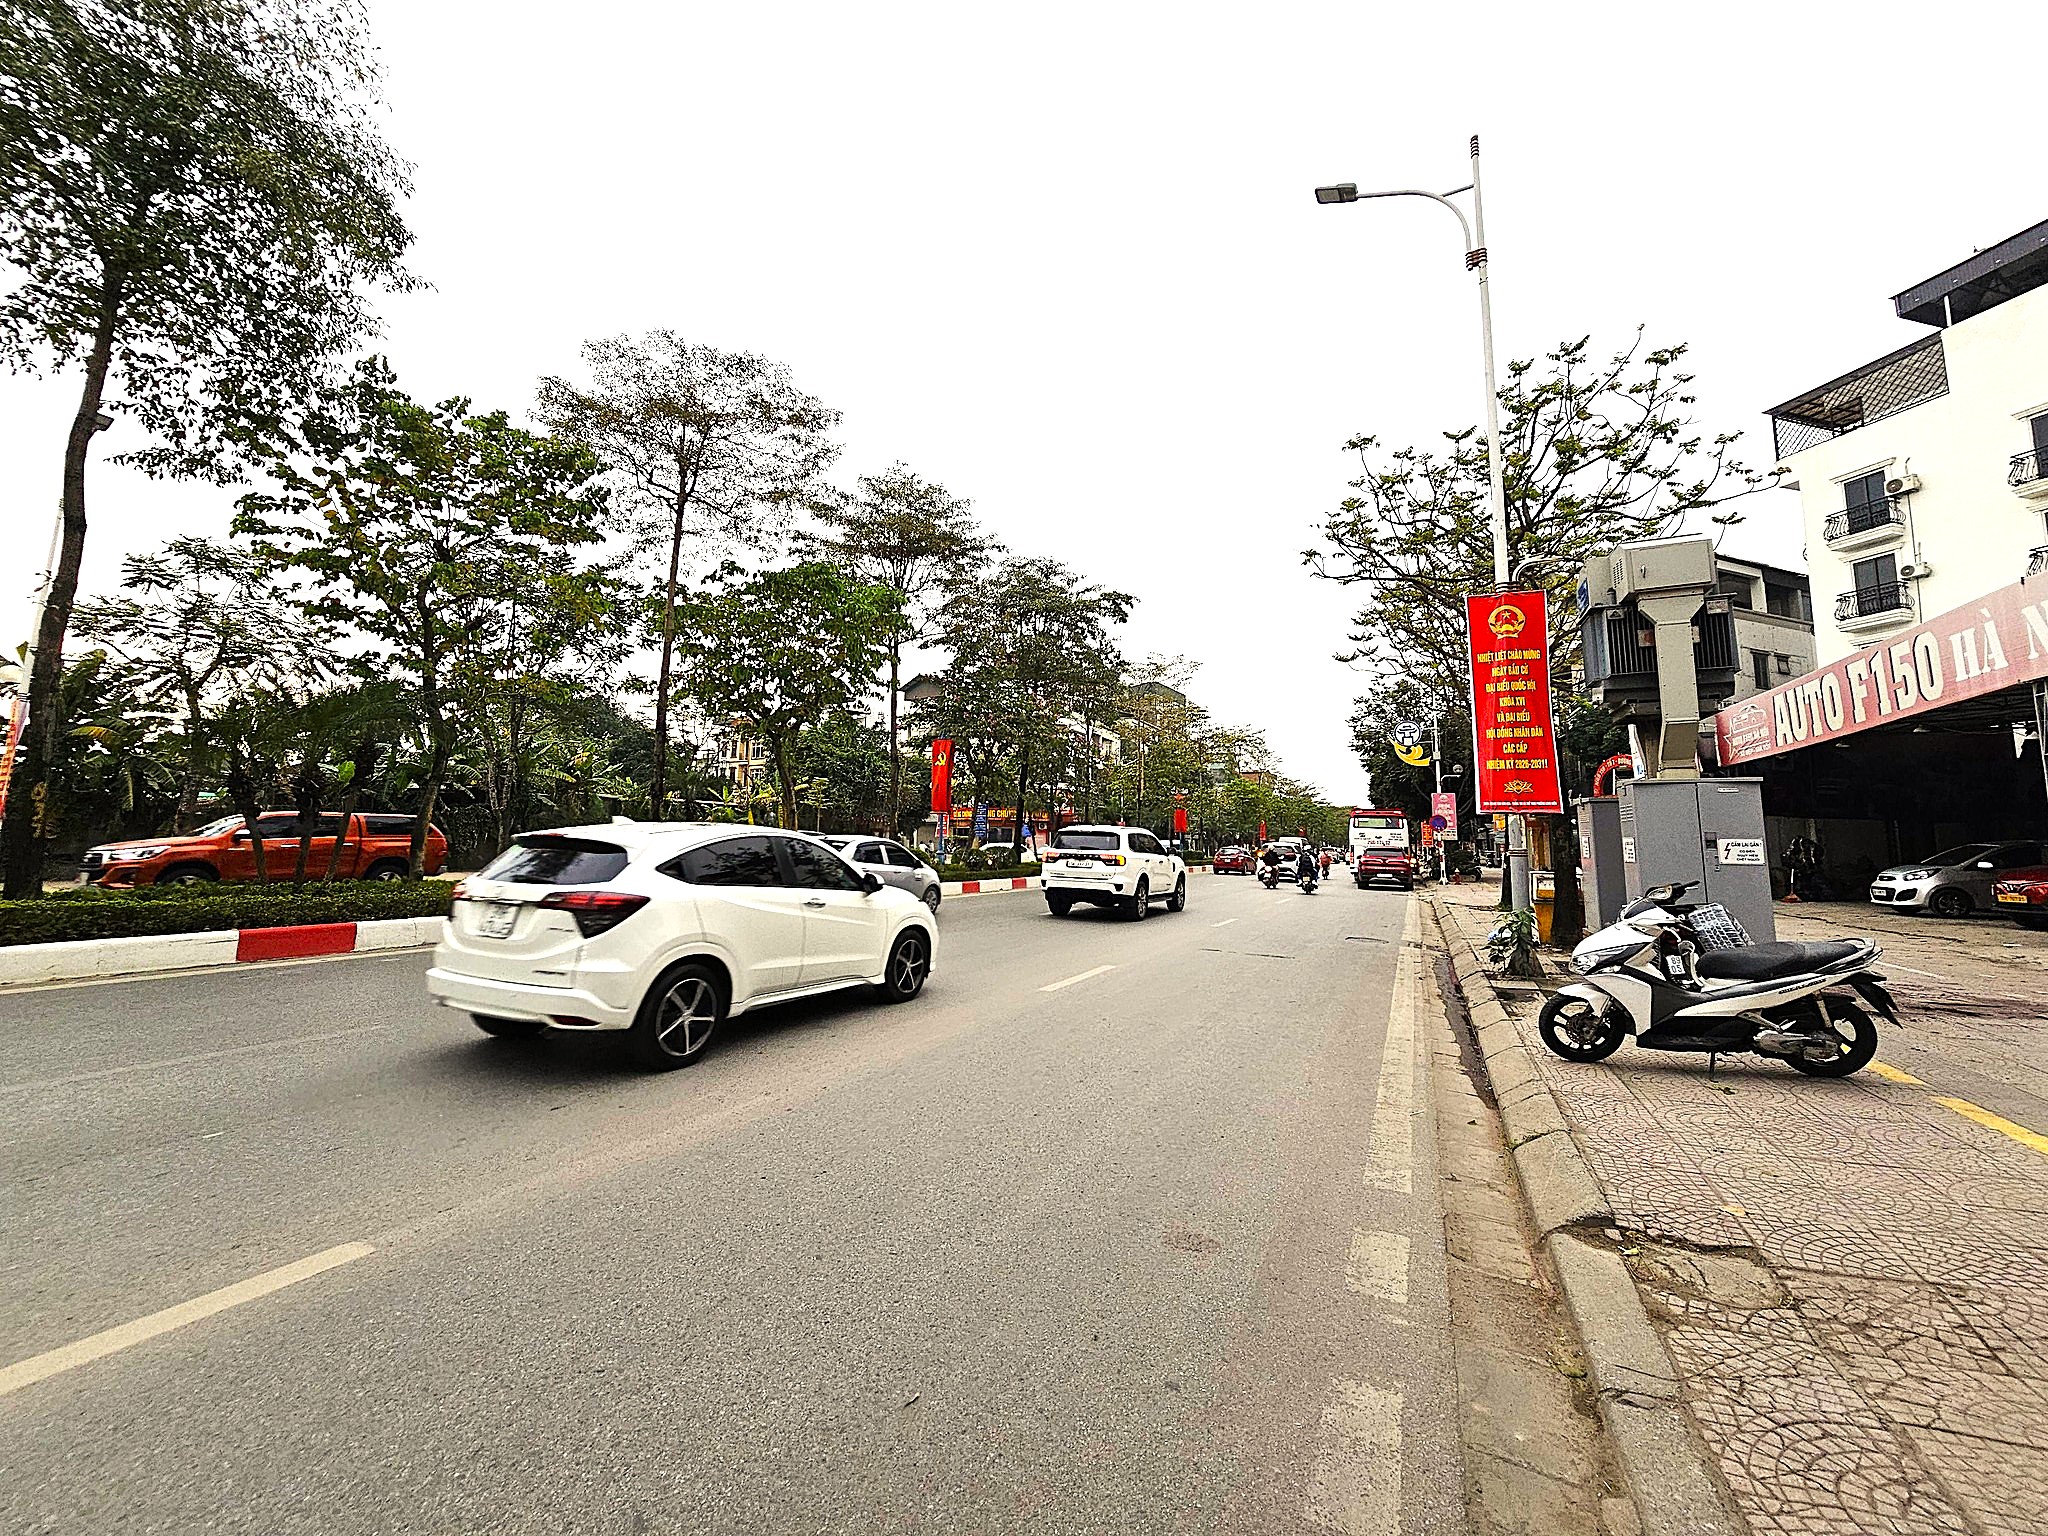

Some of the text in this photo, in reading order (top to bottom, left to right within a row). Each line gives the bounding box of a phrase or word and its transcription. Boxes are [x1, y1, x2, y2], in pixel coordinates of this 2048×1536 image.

[1477, 648, 1541, 664] NHIỆT LIỆT CHÀO MỪNG
[1491, 663, 1529, 677] NGÀY BẦU CỬ
[1772, 672, 1845, 748] AUTO
[1844, 630, 1944, 724] F150
[1949, 607, 2009, 682] HÀ
[1486, 678, 1537, 694] ĐẠI BIỂU QUỐC HỘI
[1499, 695, 1526, 707] KHÓA XVI
[1497, 708, 1530, 724] VÀ ĐẠI BIỂU
[1486, 726, 1543, 741] HỘI ĐỒNG NHÂN DÂN
[1503, 740, 1528, 754] CÁC CẤP
[1486, 758, 1505, 771] NHIỆM
